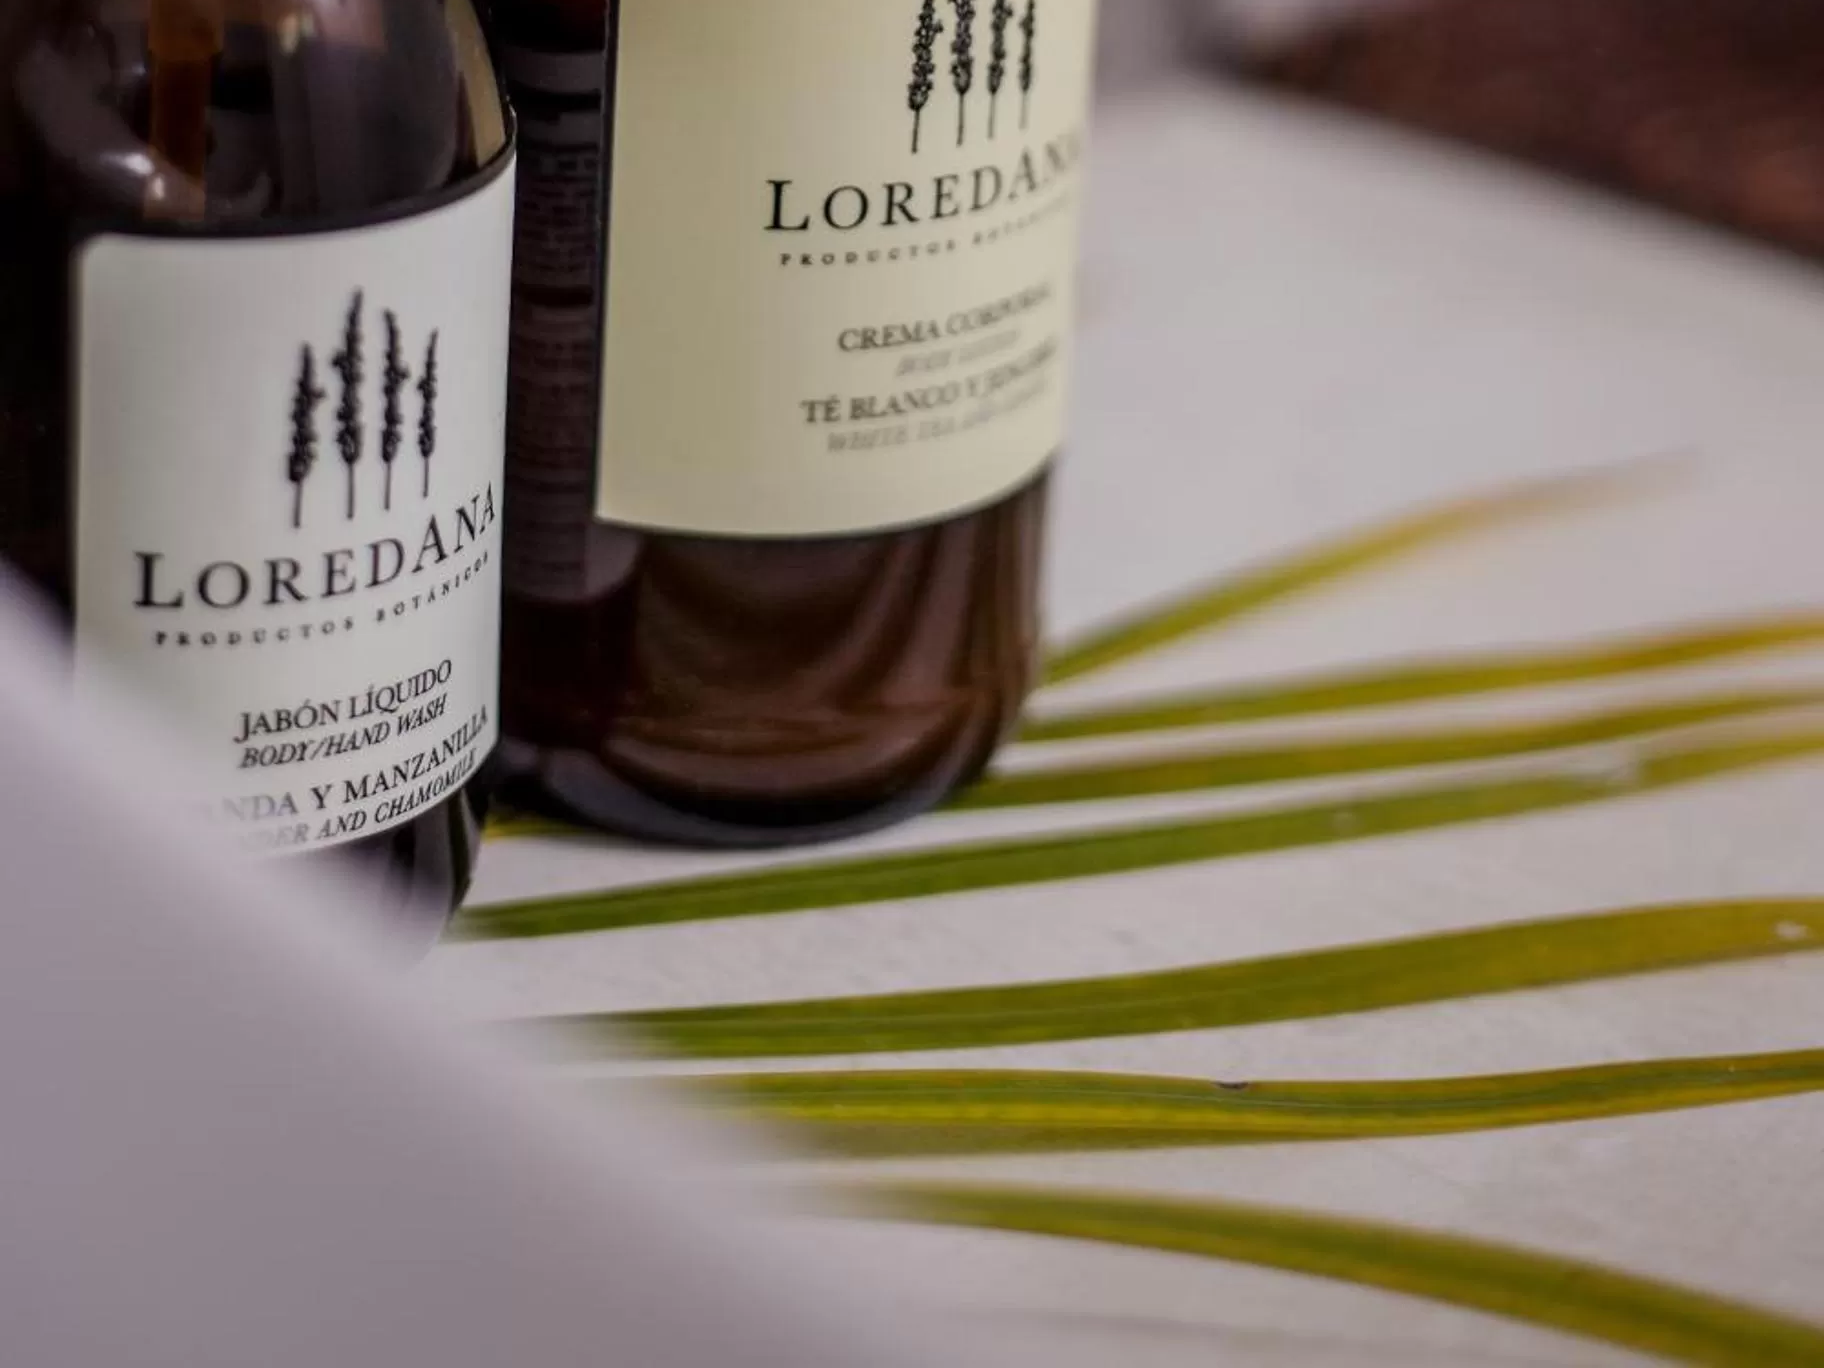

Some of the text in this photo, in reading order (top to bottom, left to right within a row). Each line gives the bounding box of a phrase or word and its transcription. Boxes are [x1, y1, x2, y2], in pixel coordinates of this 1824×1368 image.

[836, 319, 942, 353] CREMA
[800, 394, 841, 423] TÉ
[848, 379, 961, 421] BLANCO
[133, 481, 495, 609] LOREDANA
[155, 616, 354, 646] PRODUCTOS
[233, 659, 452, 744] JABÓN LÍQUIDO
[237, 692, 448, 769] BODY/HAND WASH
[310, 783, 333, 810] Y
[343, 703, 488, 803] MANZANILLA
[316, 811, 367, 840] AND
[374, 747, 477, 823] CHAMOMILE
